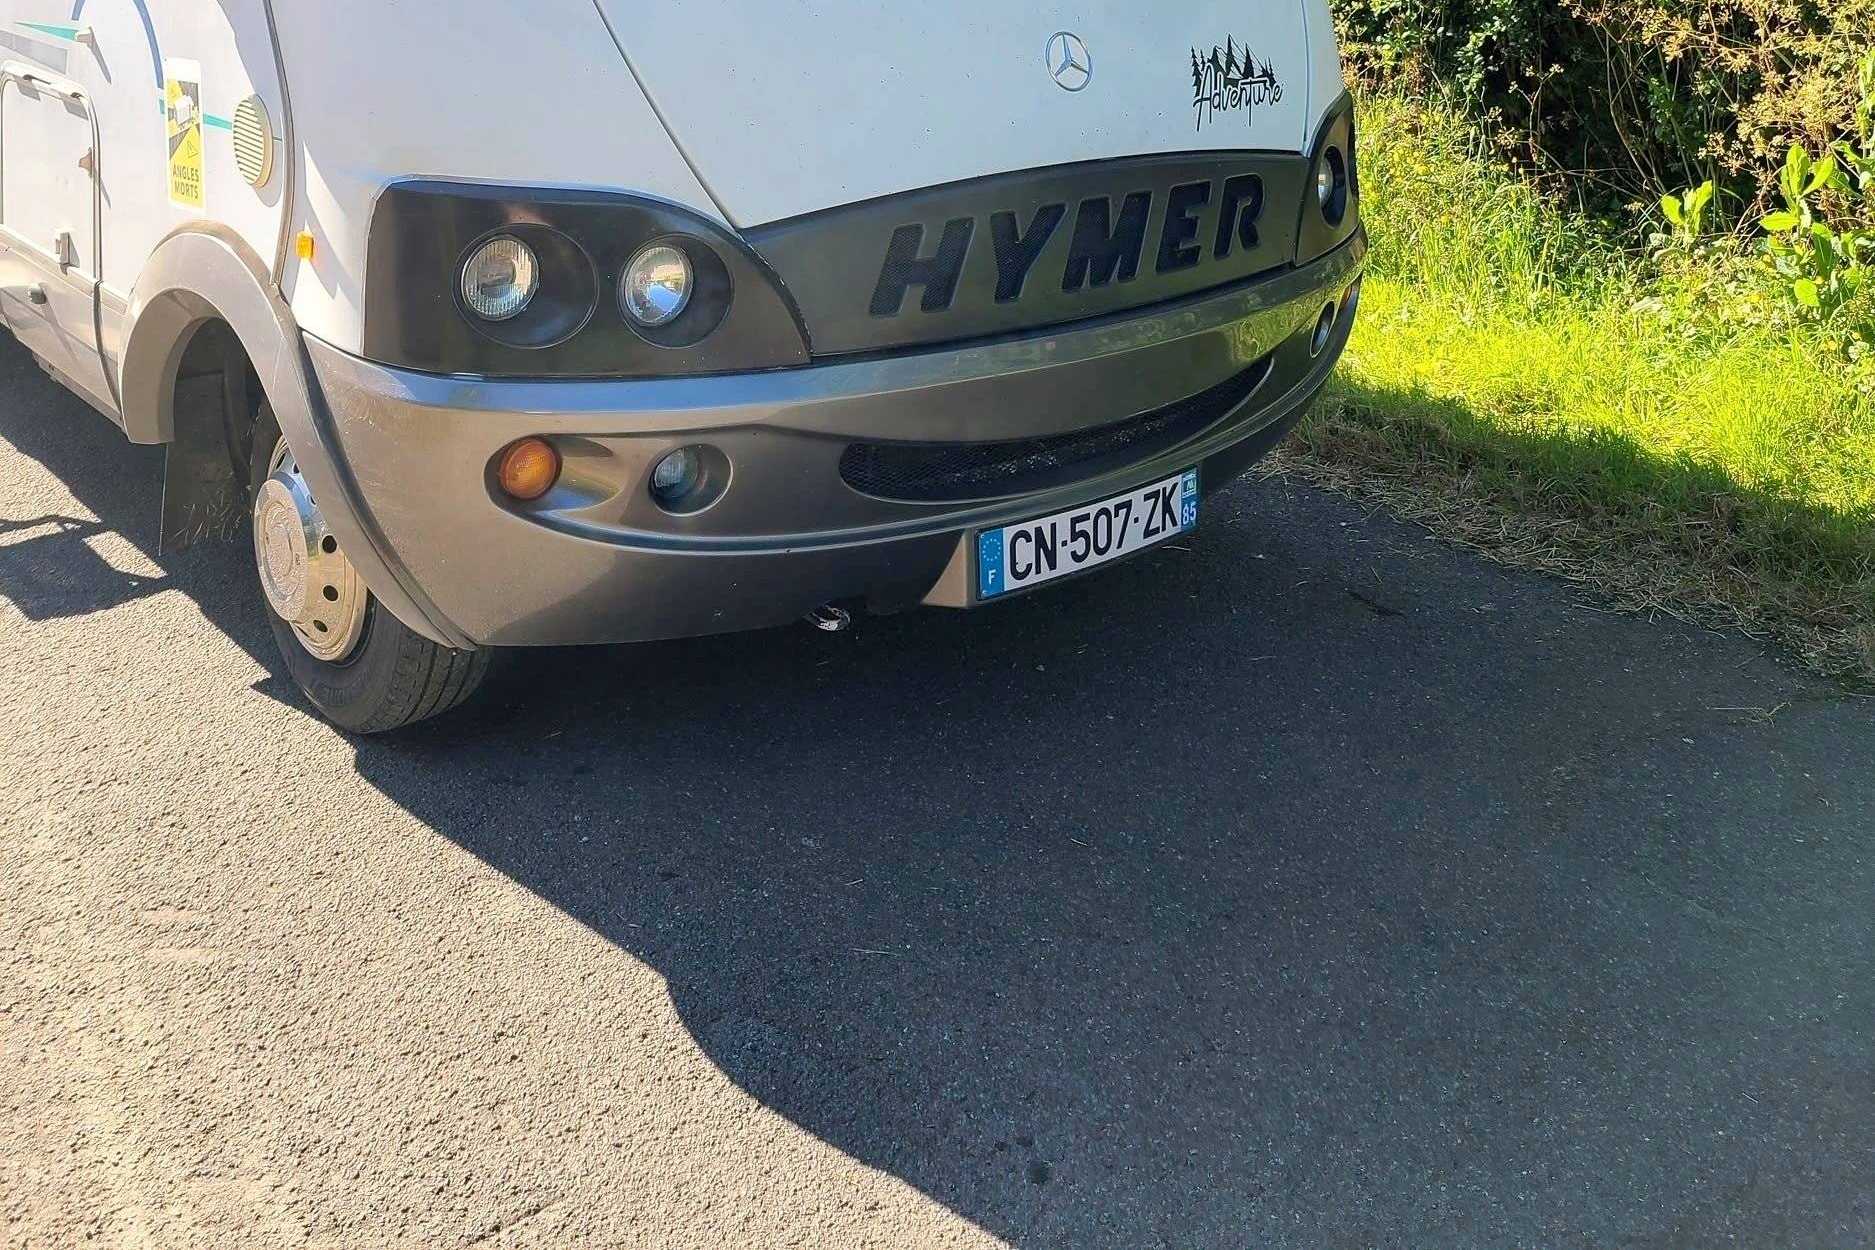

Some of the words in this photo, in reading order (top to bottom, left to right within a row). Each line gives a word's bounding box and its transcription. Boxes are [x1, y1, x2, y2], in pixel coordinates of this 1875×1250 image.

[1193, 62, 1283, 132] Adventure
[172, 163, 200, 183] ANGLES
[174, 180, 199, 199] MORTS
[868, 173, 1265, 318] HYMER
[987, 568, 997, 585] F
[1182, 501, 1197, 525] 85
